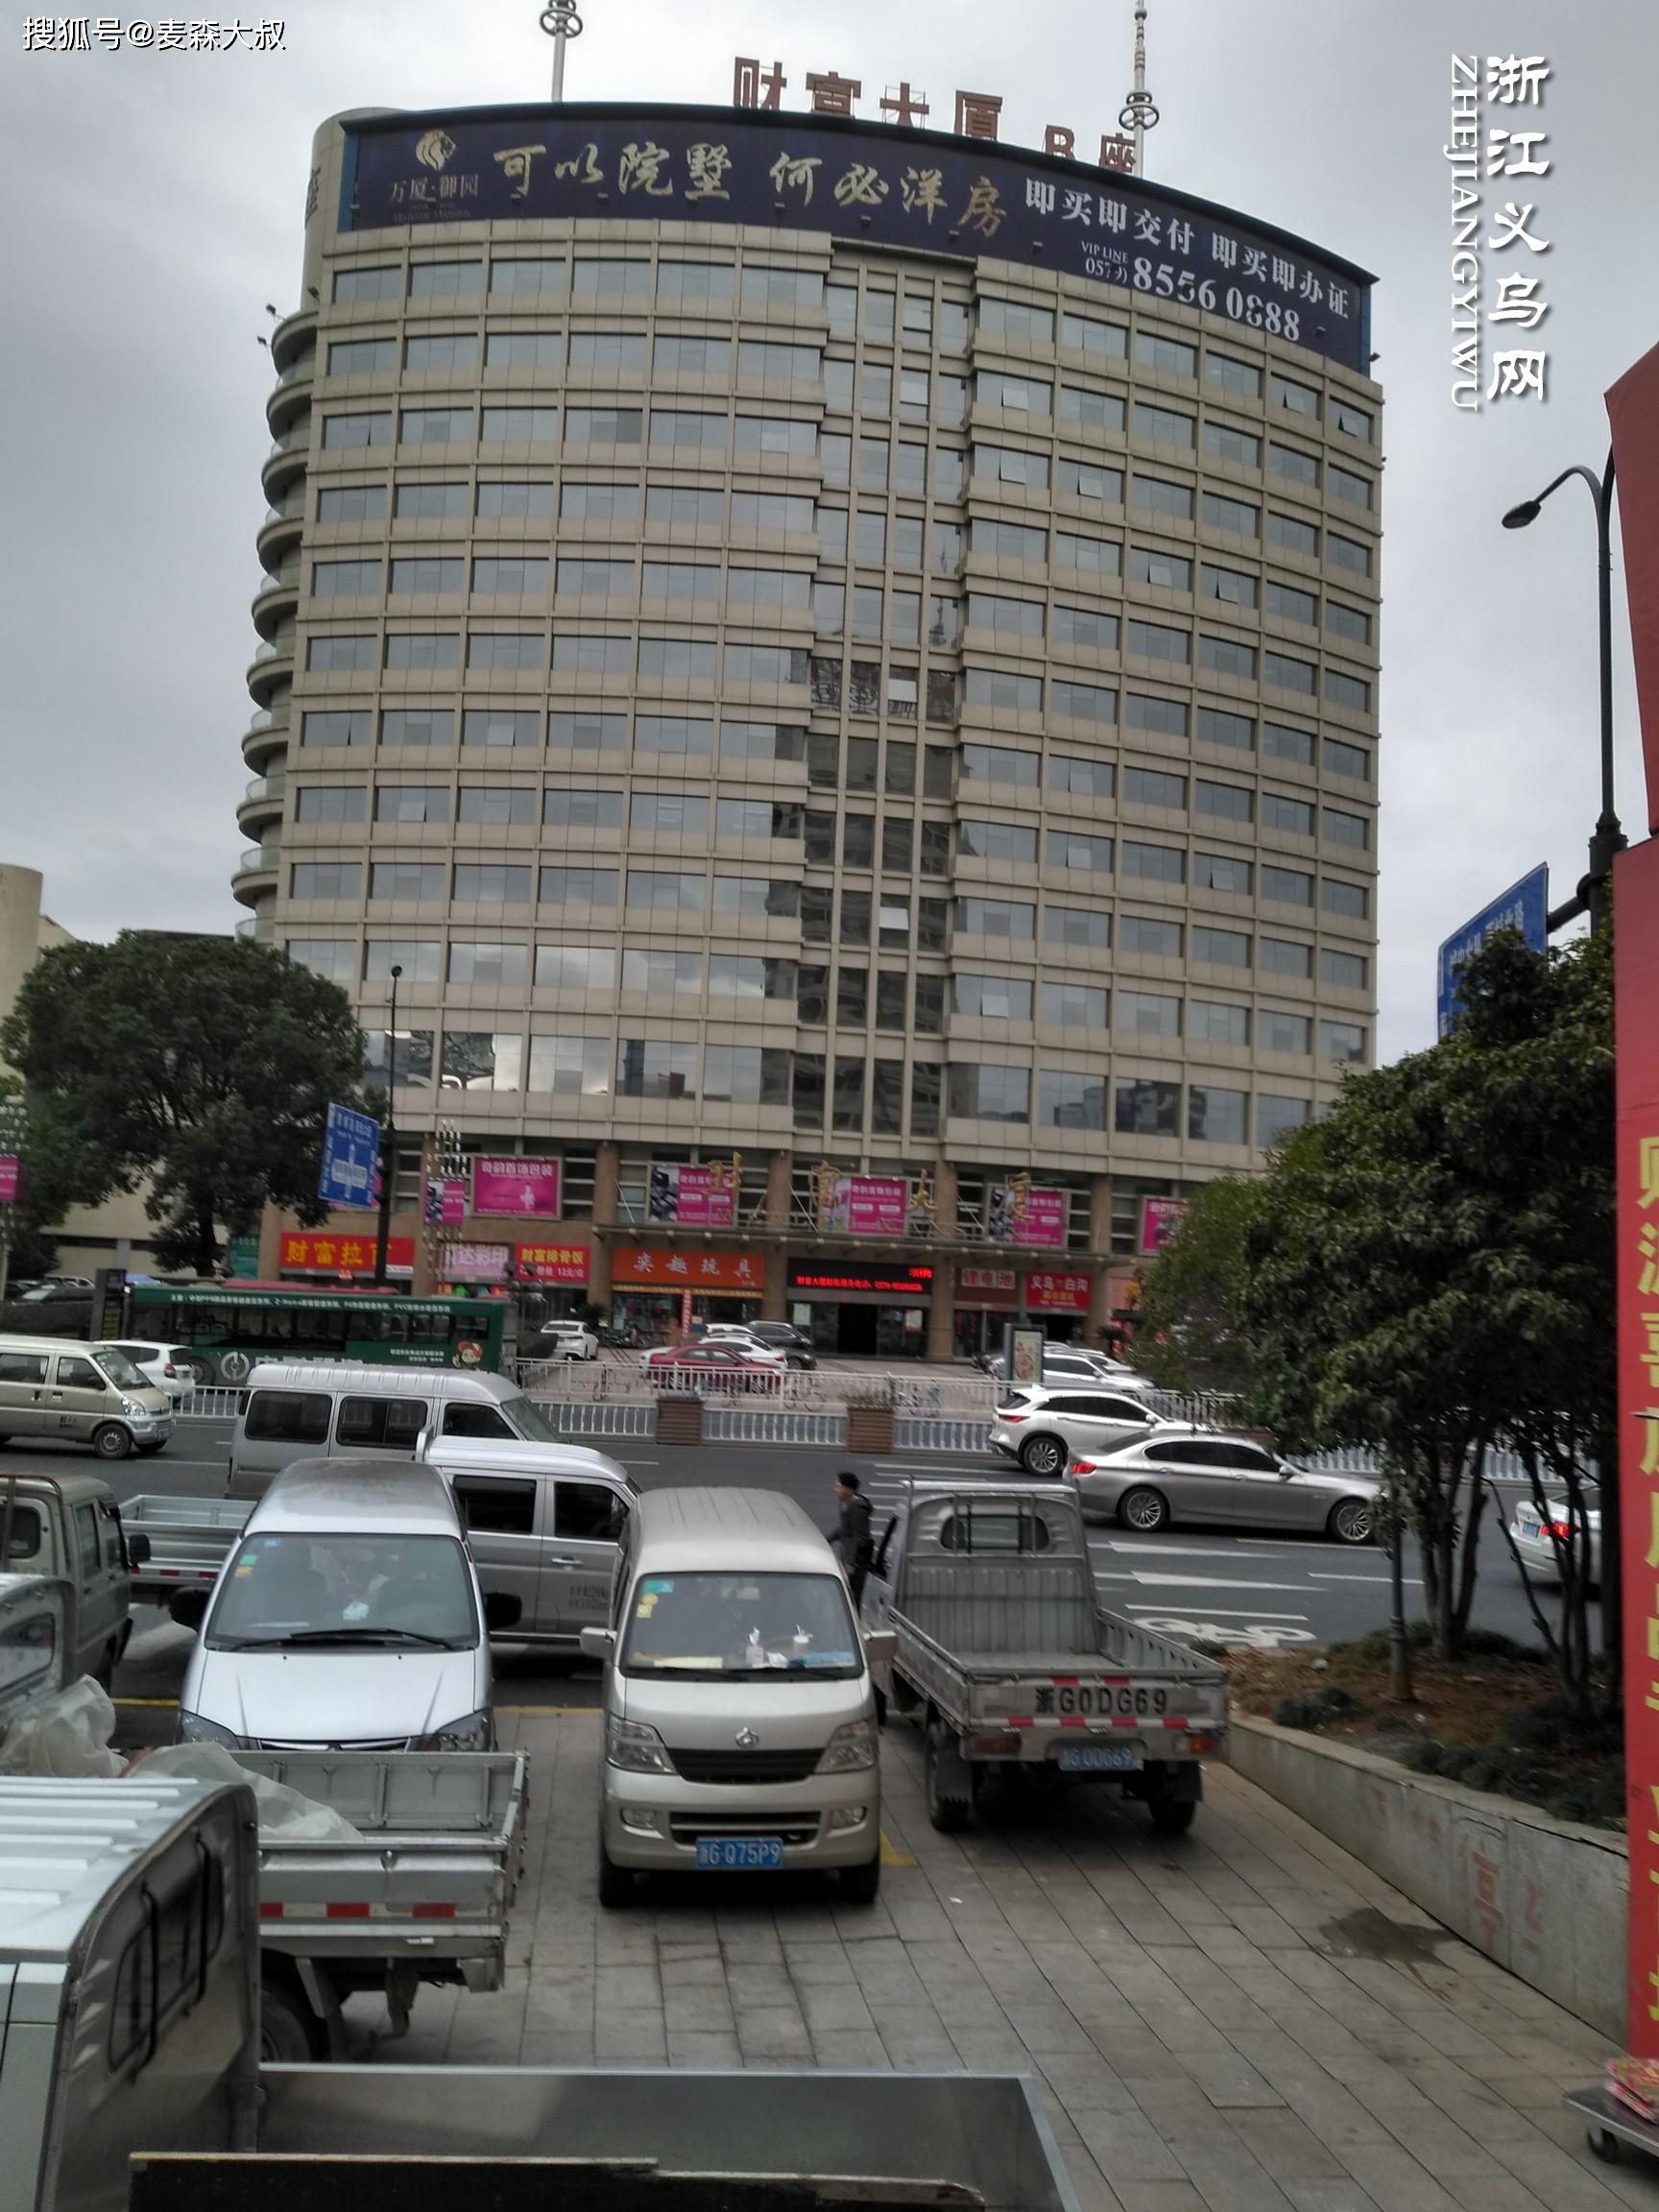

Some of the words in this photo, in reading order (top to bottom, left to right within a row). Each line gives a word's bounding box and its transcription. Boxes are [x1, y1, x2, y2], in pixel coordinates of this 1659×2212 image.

[733, 56, 1003, 140] 财富大厦
[493, 141, 732, 200] 可以院墅
[770, 152, 1008, 238] 何必洋房
[1025, 177, 1195, 255] 即买即交付
[1212, 231, 1350, 321] 即买即办证
[1081, 240, 1100, 255] VIP
[1102, 246, 1128, 264] LINE
[1133, 256, 1216, 311] 8556
